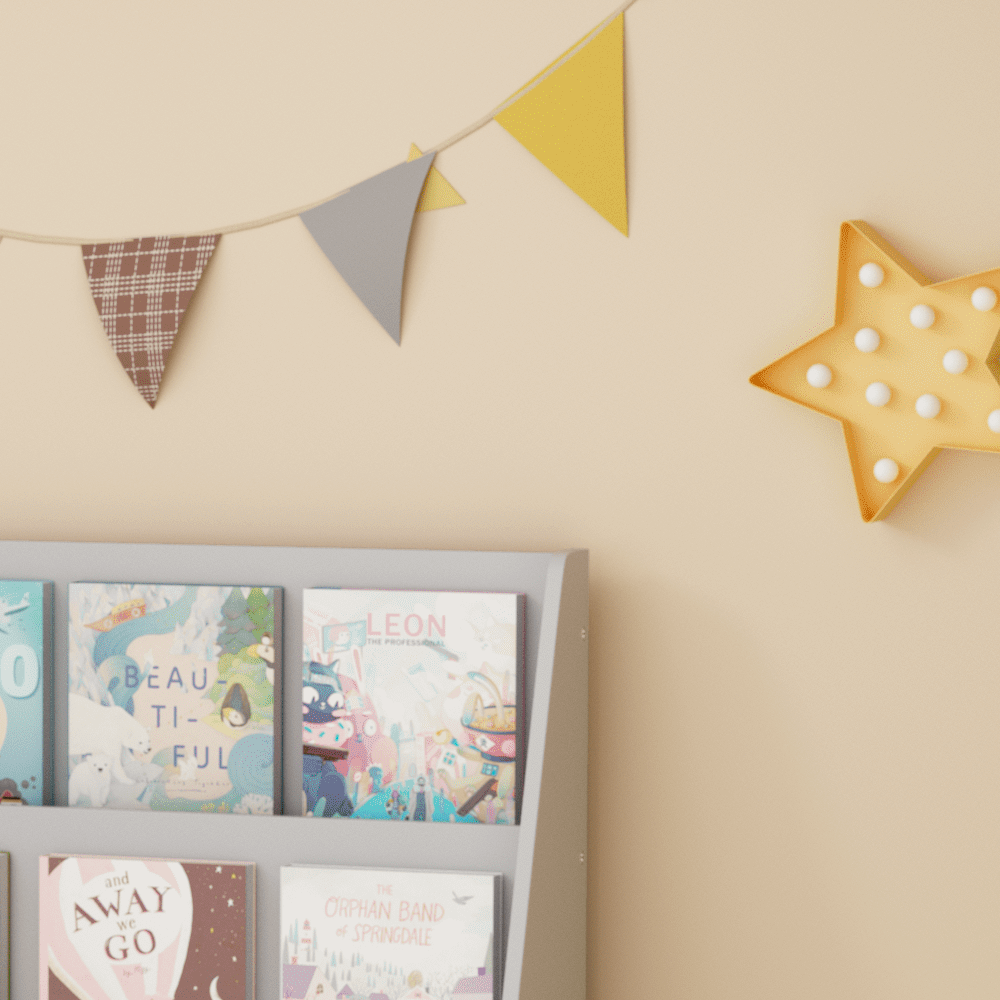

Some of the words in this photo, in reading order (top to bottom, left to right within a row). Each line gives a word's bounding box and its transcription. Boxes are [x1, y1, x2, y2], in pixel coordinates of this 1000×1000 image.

[366, 612, 447, 637] LEON
[367, 637, 381, 646] THE
[172, 744, 229, 770] FUL
[104, 870, 130, 888] and
[376, 883, 393, 896] THE
[72, 885, 173, 933] AWAY
[323, 895, 392, 921] ORPHAN
[398, 900, 446, 923] BAND
[116, 918, 137, 931] we
[335, 924, 348, 938] of
[351, 923, 433, 947] SPRINGDALE
[103, 927, 157, 962] GO
